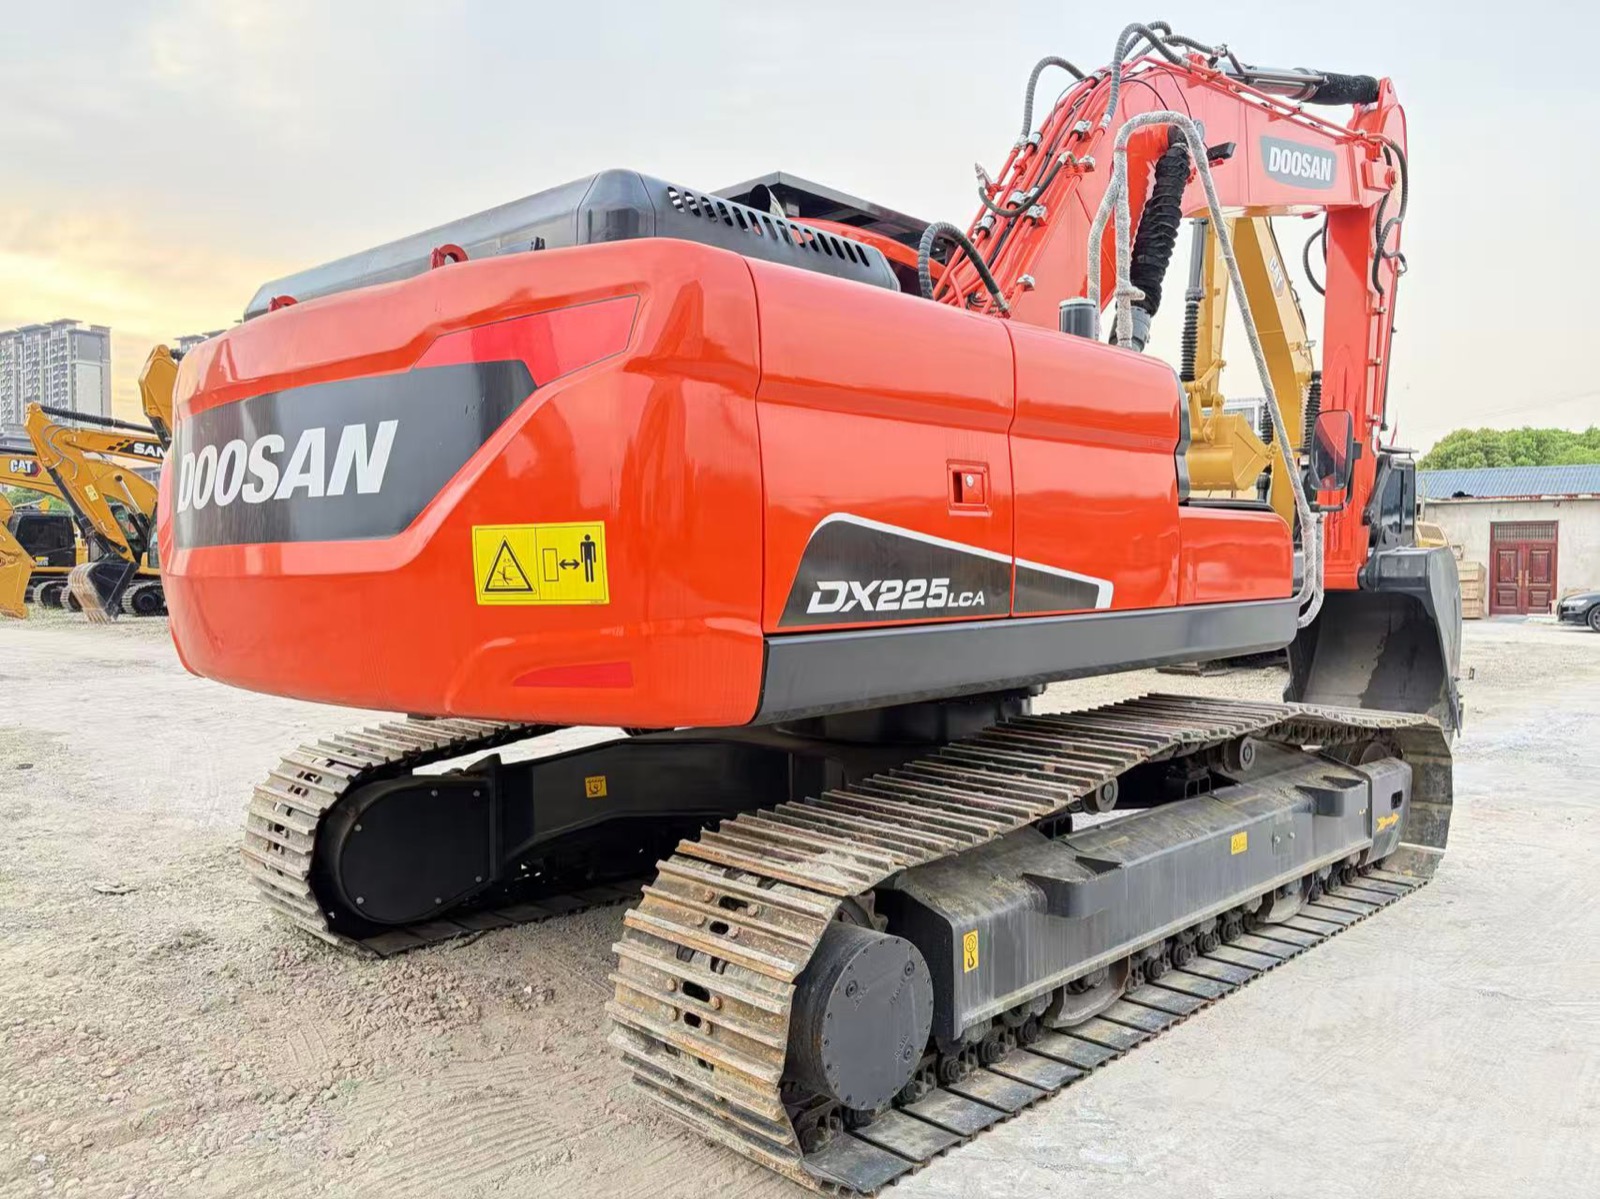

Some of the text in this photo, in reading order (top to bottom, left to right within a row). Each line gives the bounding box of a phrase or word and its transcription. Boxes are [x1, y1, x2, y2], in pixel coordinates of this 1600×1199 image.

[1268, 146, 1332, 182] DOOSAN
[10, 459, 33, 473] CAT
[177, 419, 399, 514] DOOSAN
[806, 577, 985, 614] DX225LCA
